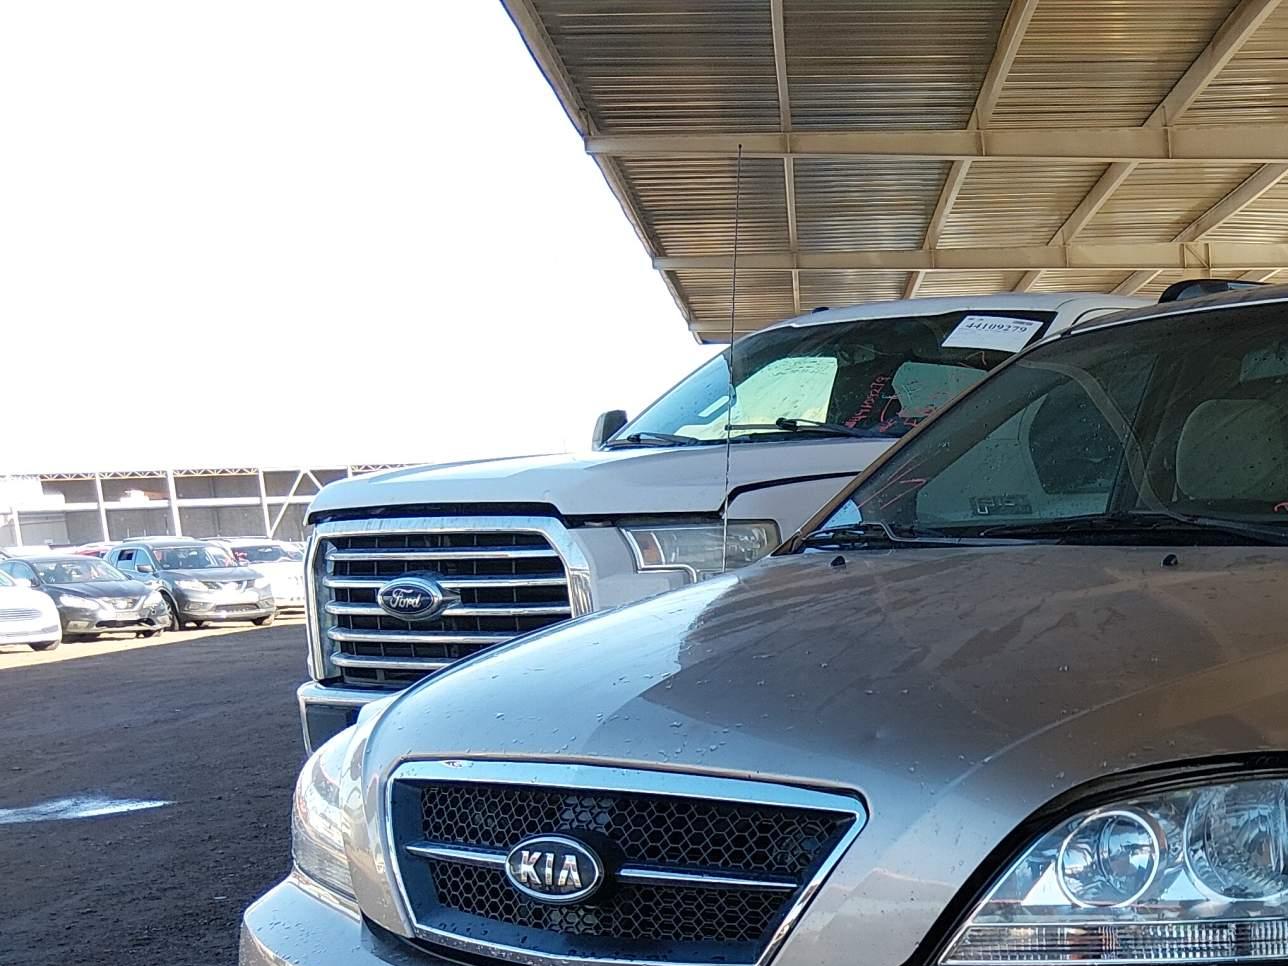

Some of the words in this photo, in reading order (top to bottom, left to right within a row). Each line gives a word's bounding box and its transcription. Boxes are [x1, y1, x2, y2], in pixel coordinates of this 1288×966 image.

[965, 322, 1028, 333] 44109279
[389, 588, 422, 608] Ford
[520, 850, 583, 888] KIA
